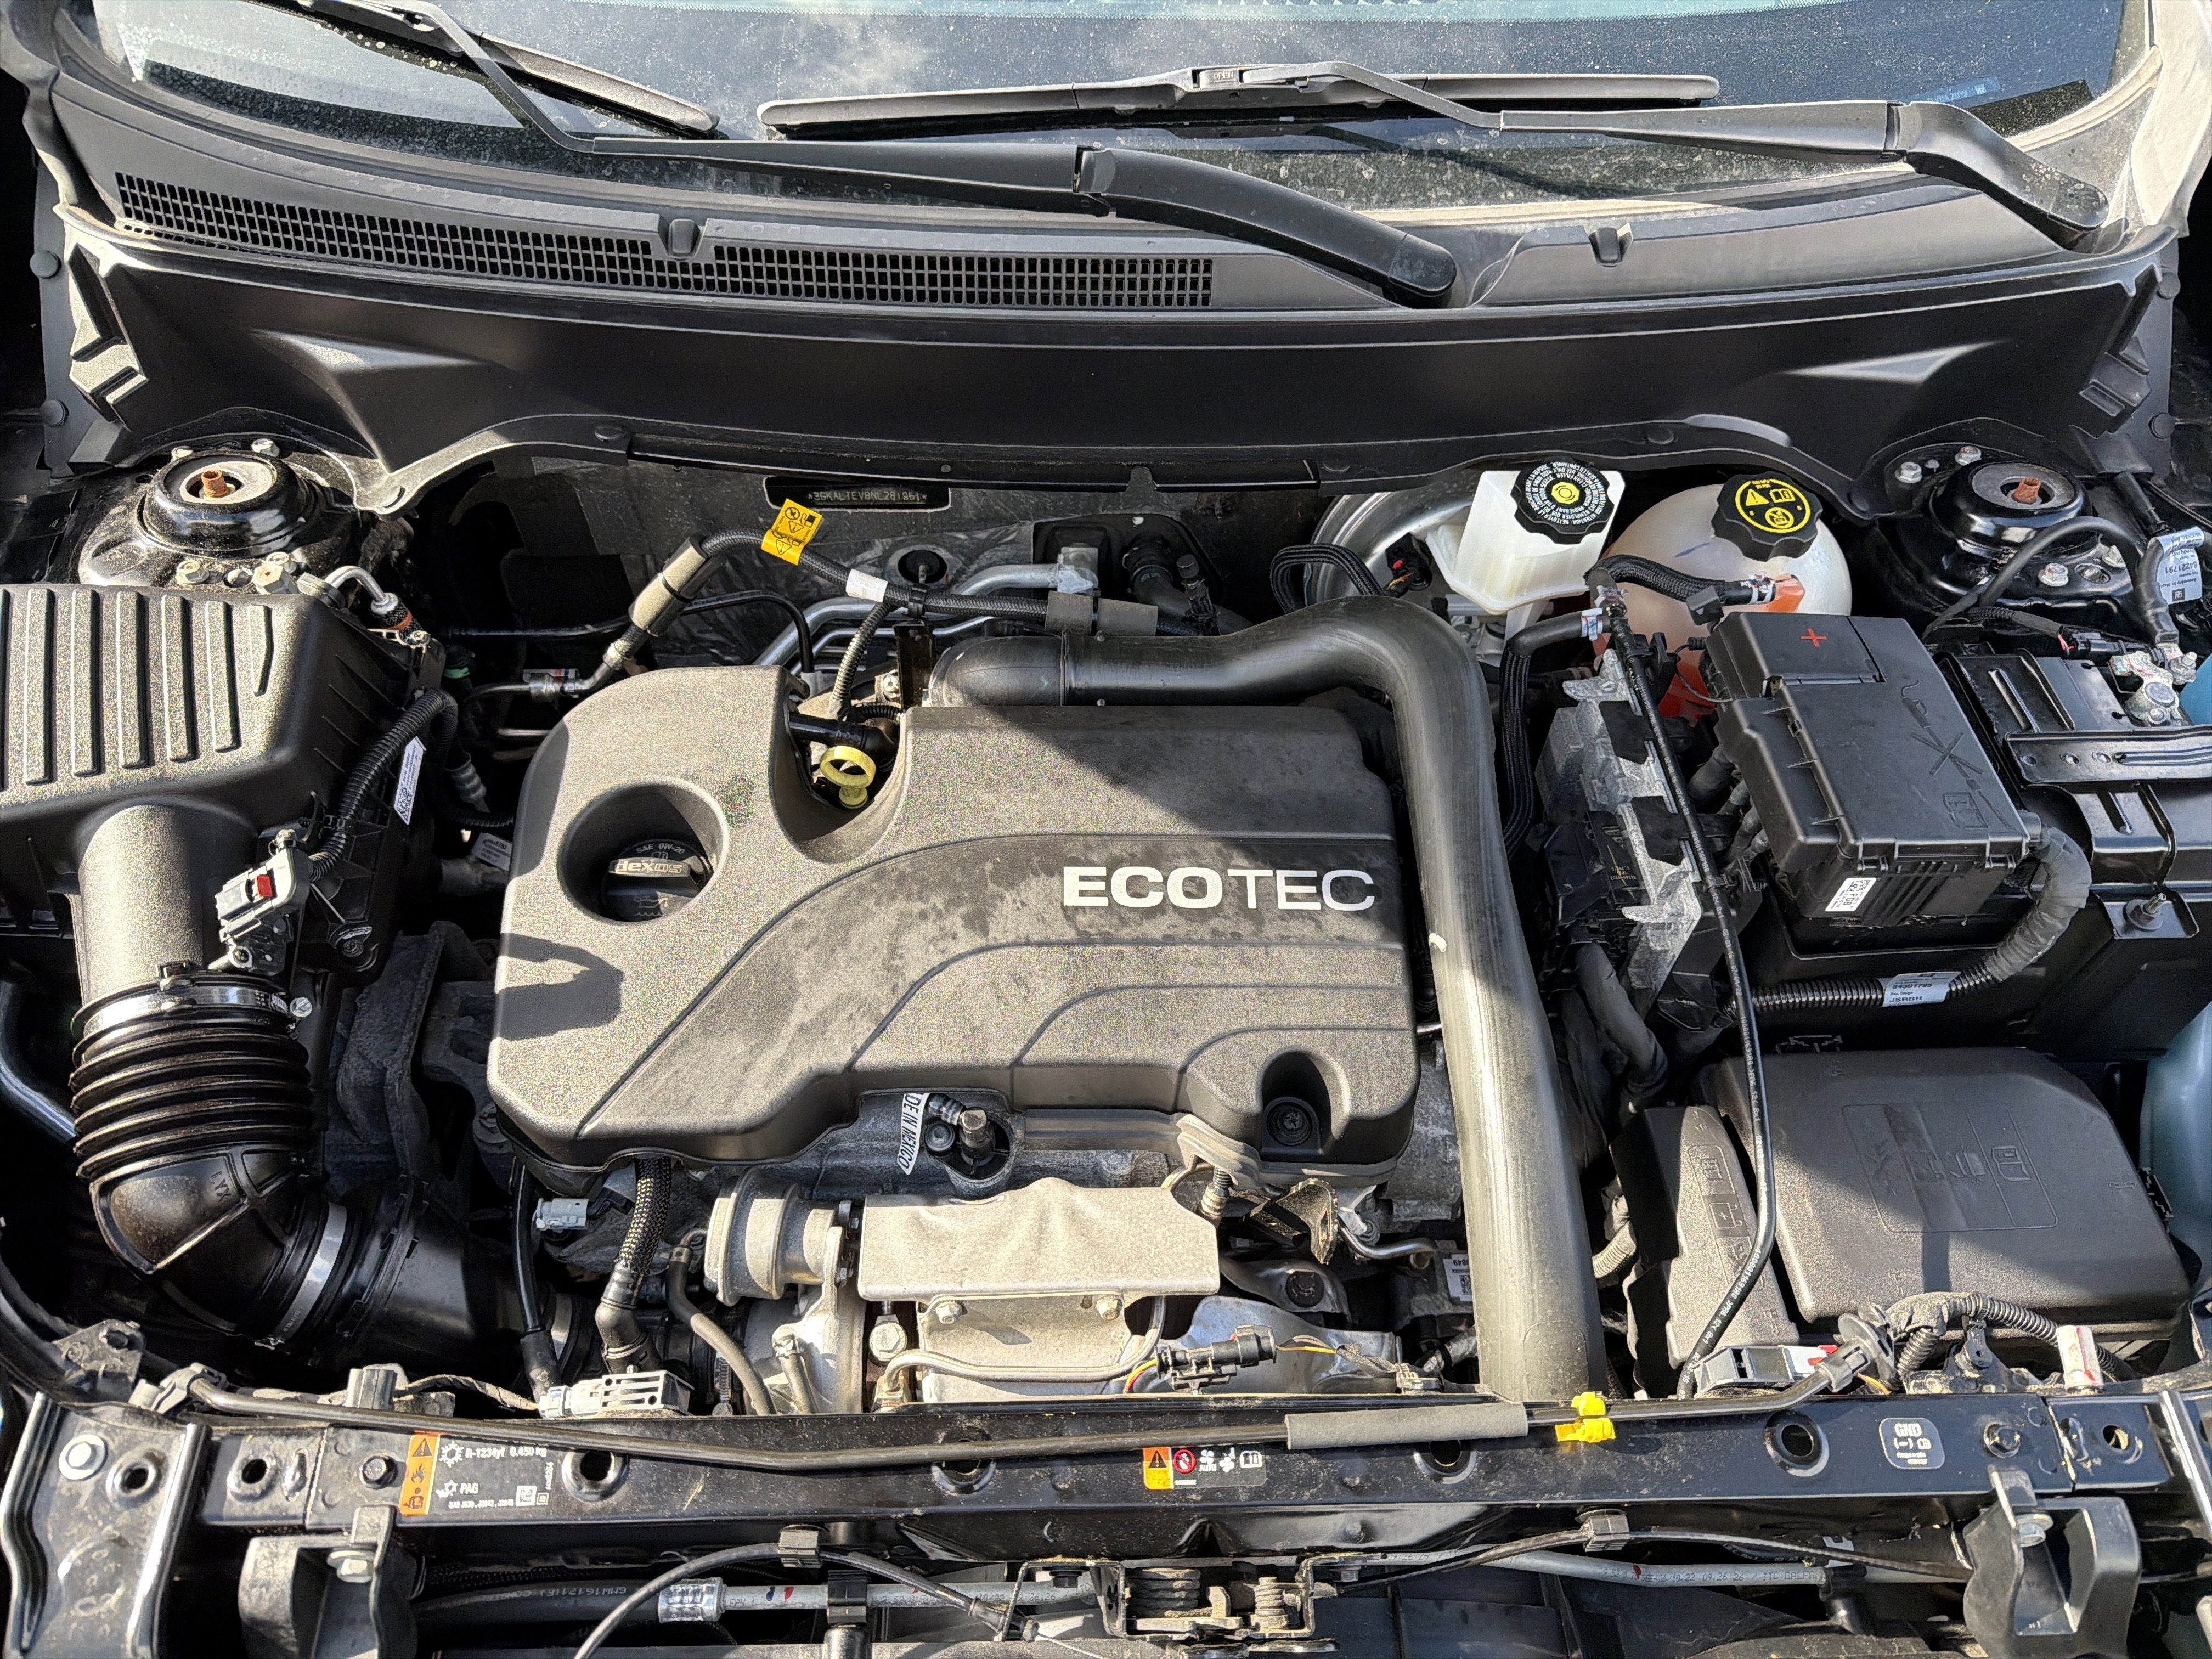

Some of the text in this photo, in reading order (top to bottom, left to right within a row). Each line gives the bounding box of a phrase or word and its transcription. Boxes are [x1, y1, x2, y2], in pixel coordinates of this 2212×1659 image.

[1214, 70, 1234, 80] OPEN
[1580, 467, 1596, 479] SEALED
[1574, 476, 1588, 487] CLEAN
[1544, 513, 1569, 524] NETTOYER
[636, 843, 685, 854] SAE 0W-20
[616, 860, 683, 873] dexos
[1063, 866, 1375, 911] ECOTEC
[1740, 1015, 1753, 1065] 1000011691A0
[898, 1093, 922, 1169] DE IN MEXICO
[1731, 1248, 1762, 1300] 1000011691A0
[1702, 1331, 1714, 1345] 8x1
[1894, 1423, 1922, 1437] GND
[465, 1446, 547, 1459] R-1234yf 0.450 kg
[1198, 1464, 1217, 1472] AUTO
[460, 1482, 479, 1495] PAG
